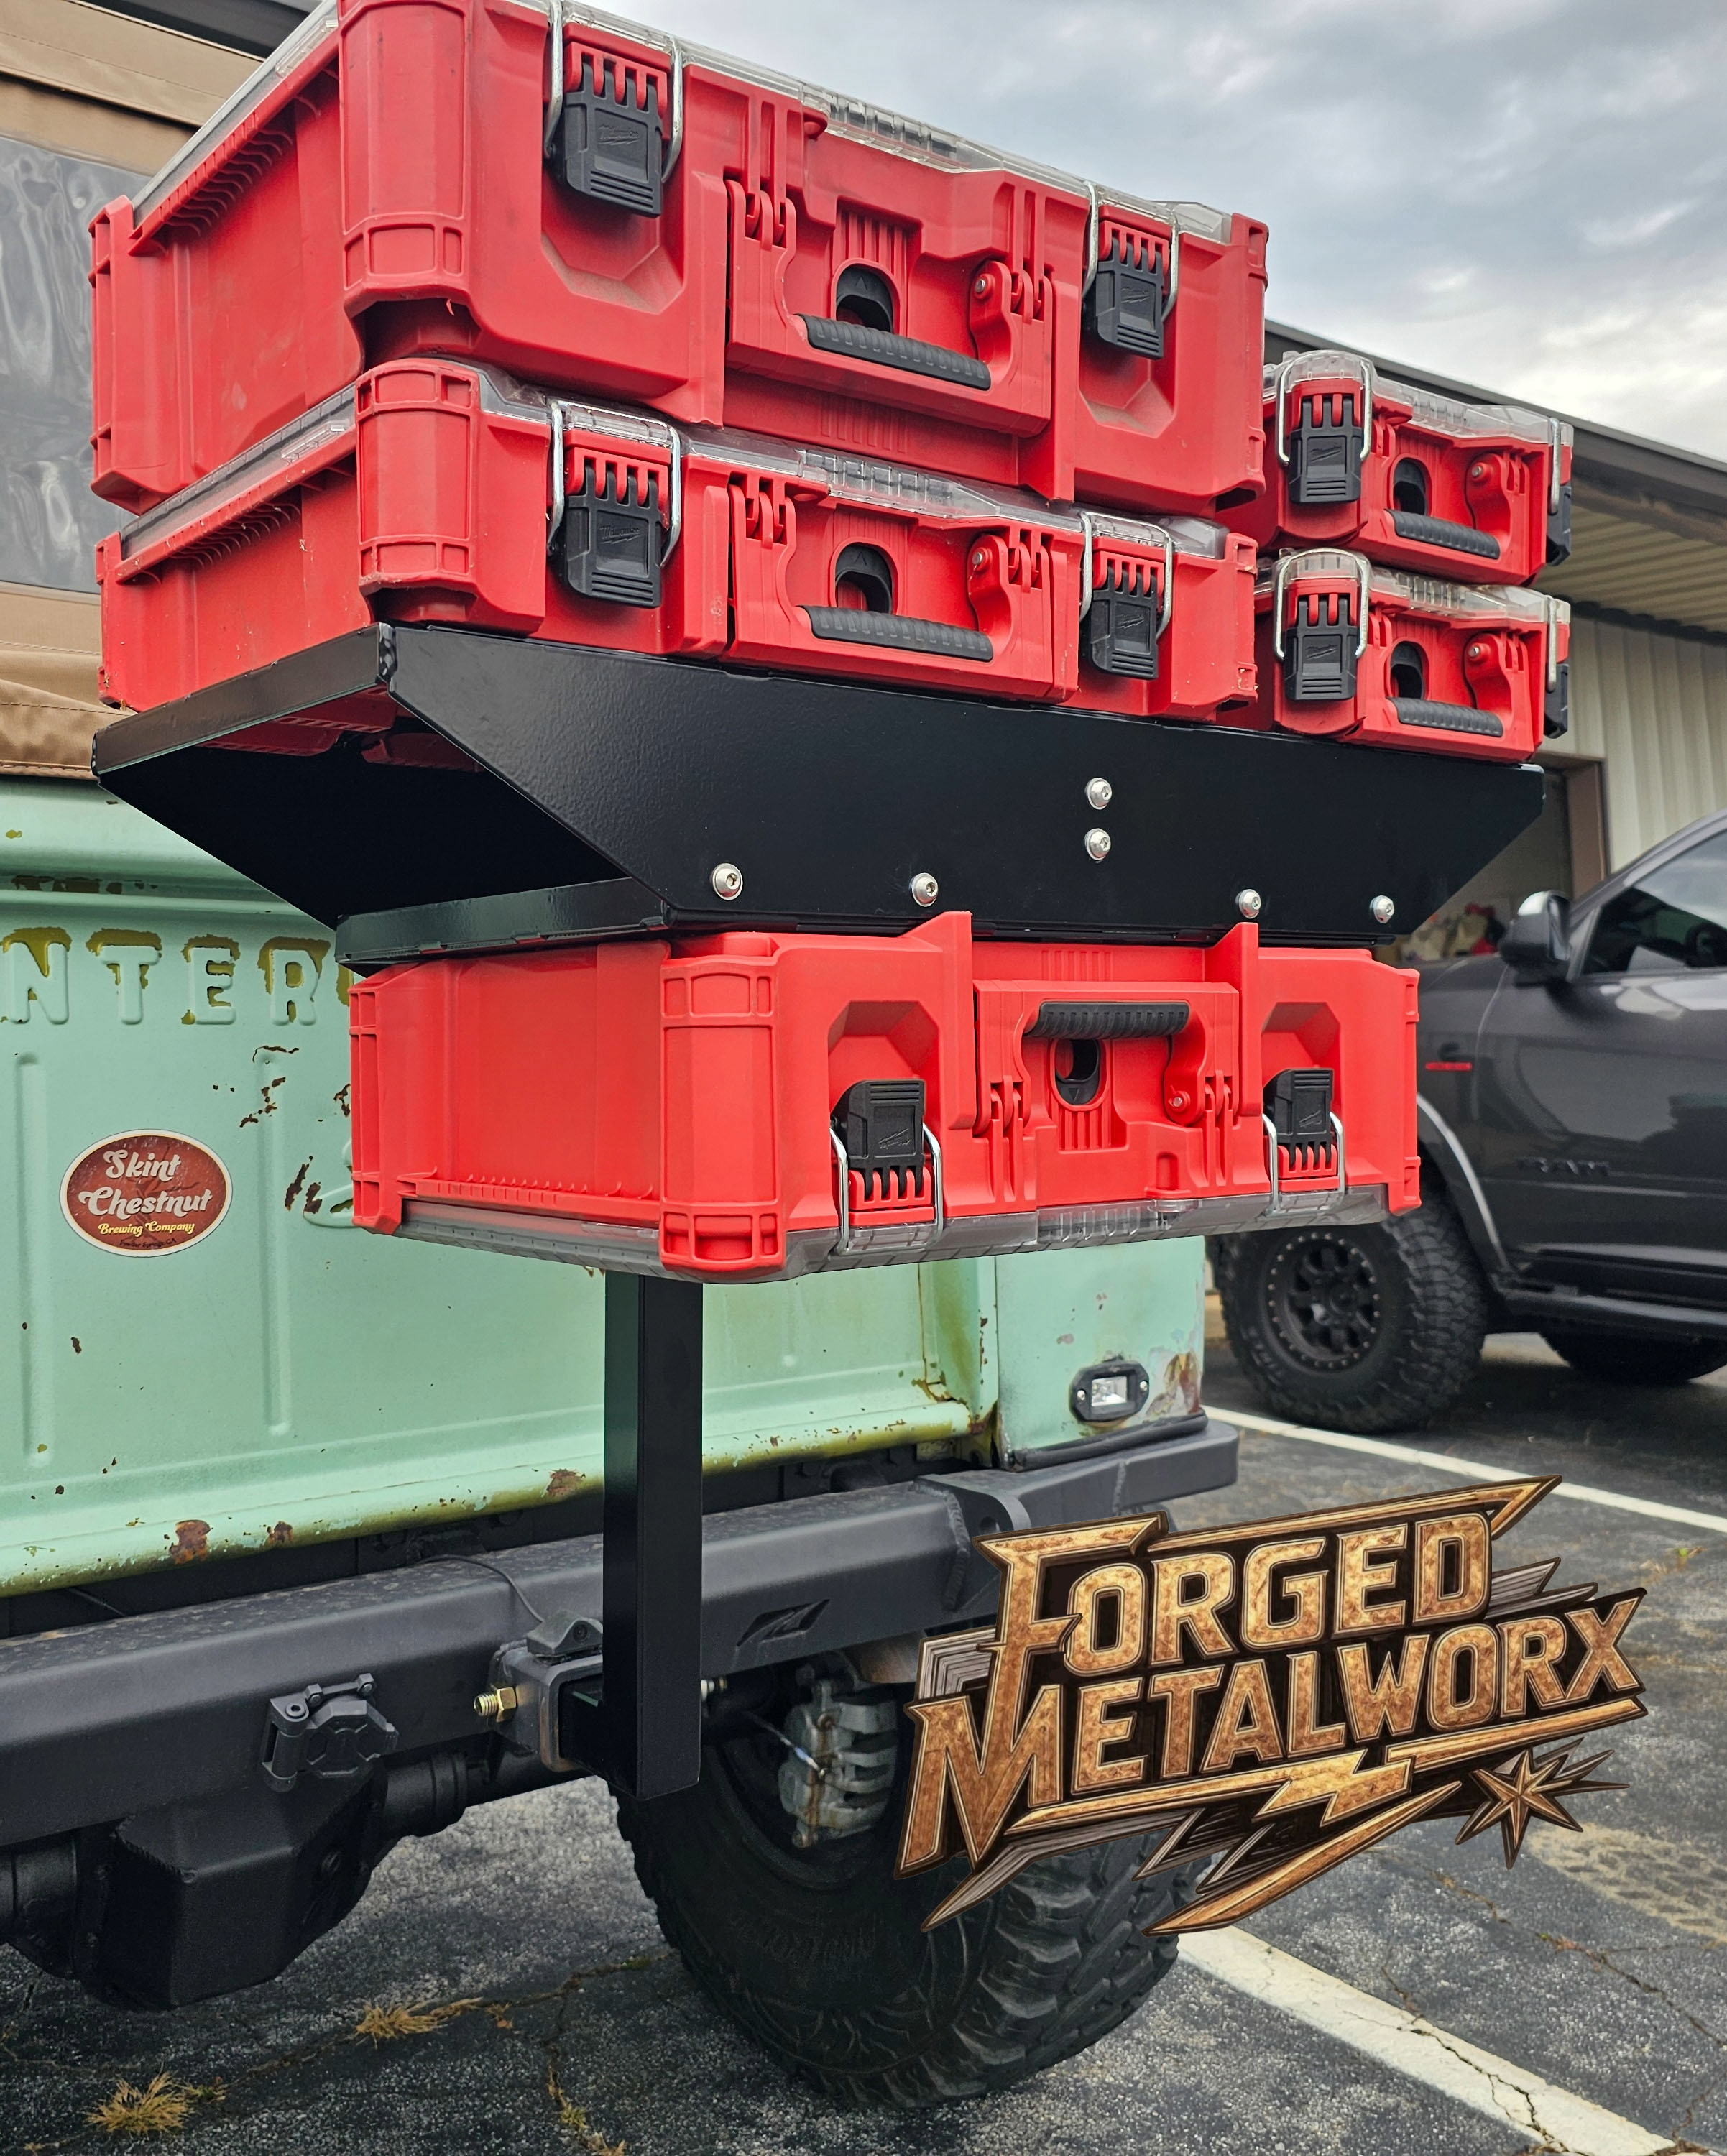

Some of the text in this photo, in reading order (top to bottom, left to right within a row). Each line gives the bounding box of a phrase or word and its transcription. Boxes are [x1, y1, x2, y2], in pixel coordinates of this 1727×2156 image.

[103, 1149, 182, 1182] Skint
[78, 1187, 213, 1220] Chestnut
[98, 1220, 195, 1237] Brewing Company
